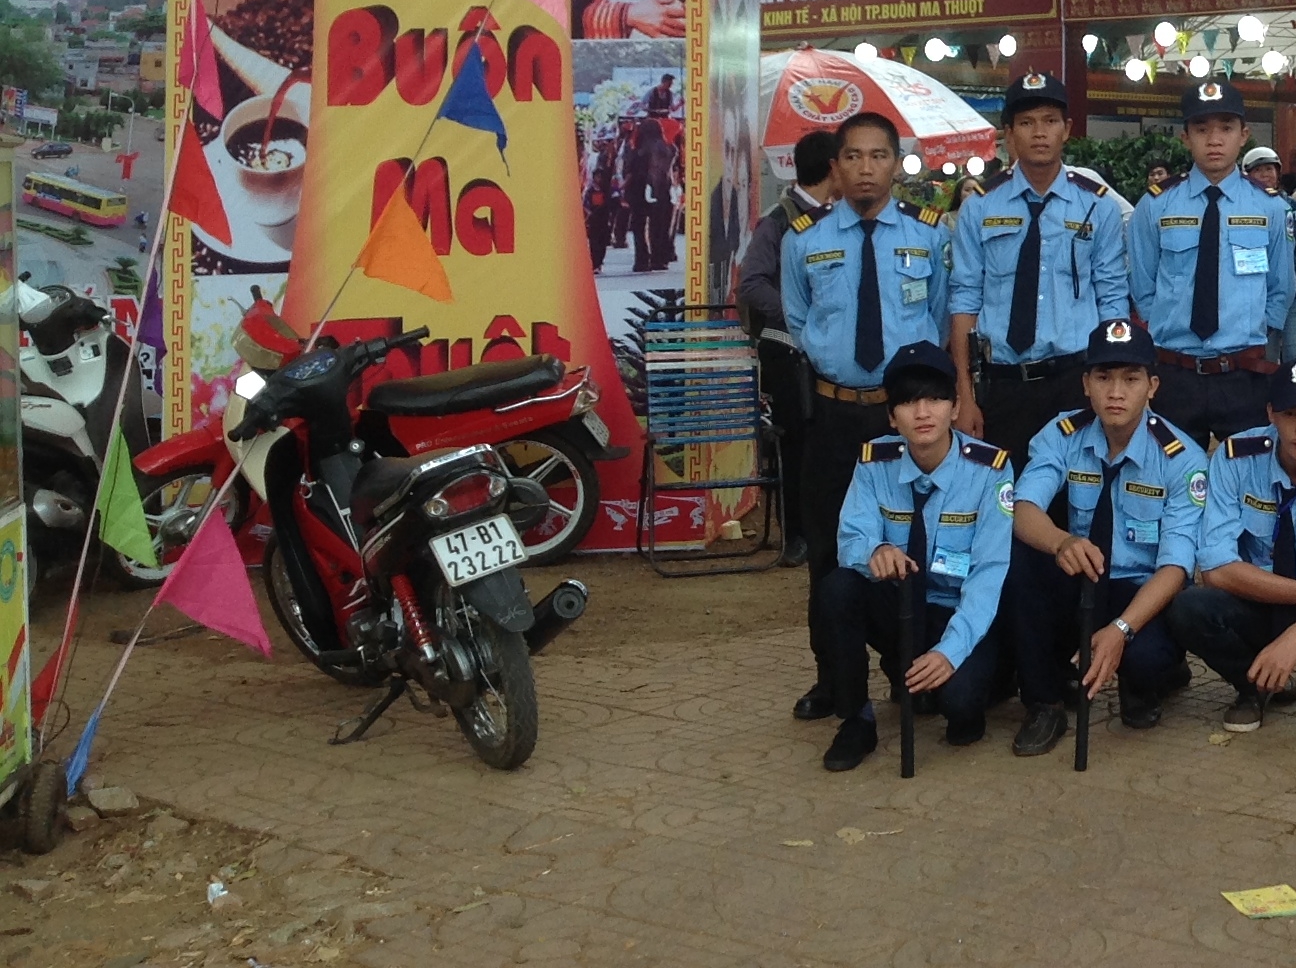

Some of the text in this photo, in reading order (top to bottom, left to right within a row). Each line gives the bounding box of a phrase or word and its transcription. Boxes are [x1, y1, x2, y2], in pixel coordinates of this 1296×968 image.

[763, 10, 793, 27] KINH
[795, 4, 811, 25] TẾ
[821, 4, 839, 23] XÃ
[840, 2, 862, 25] HỘI
[919, 0, 941, 18] MA
[445, 520, 504, 555] 47-B1
[447, 539, 523, 582] 232.22
